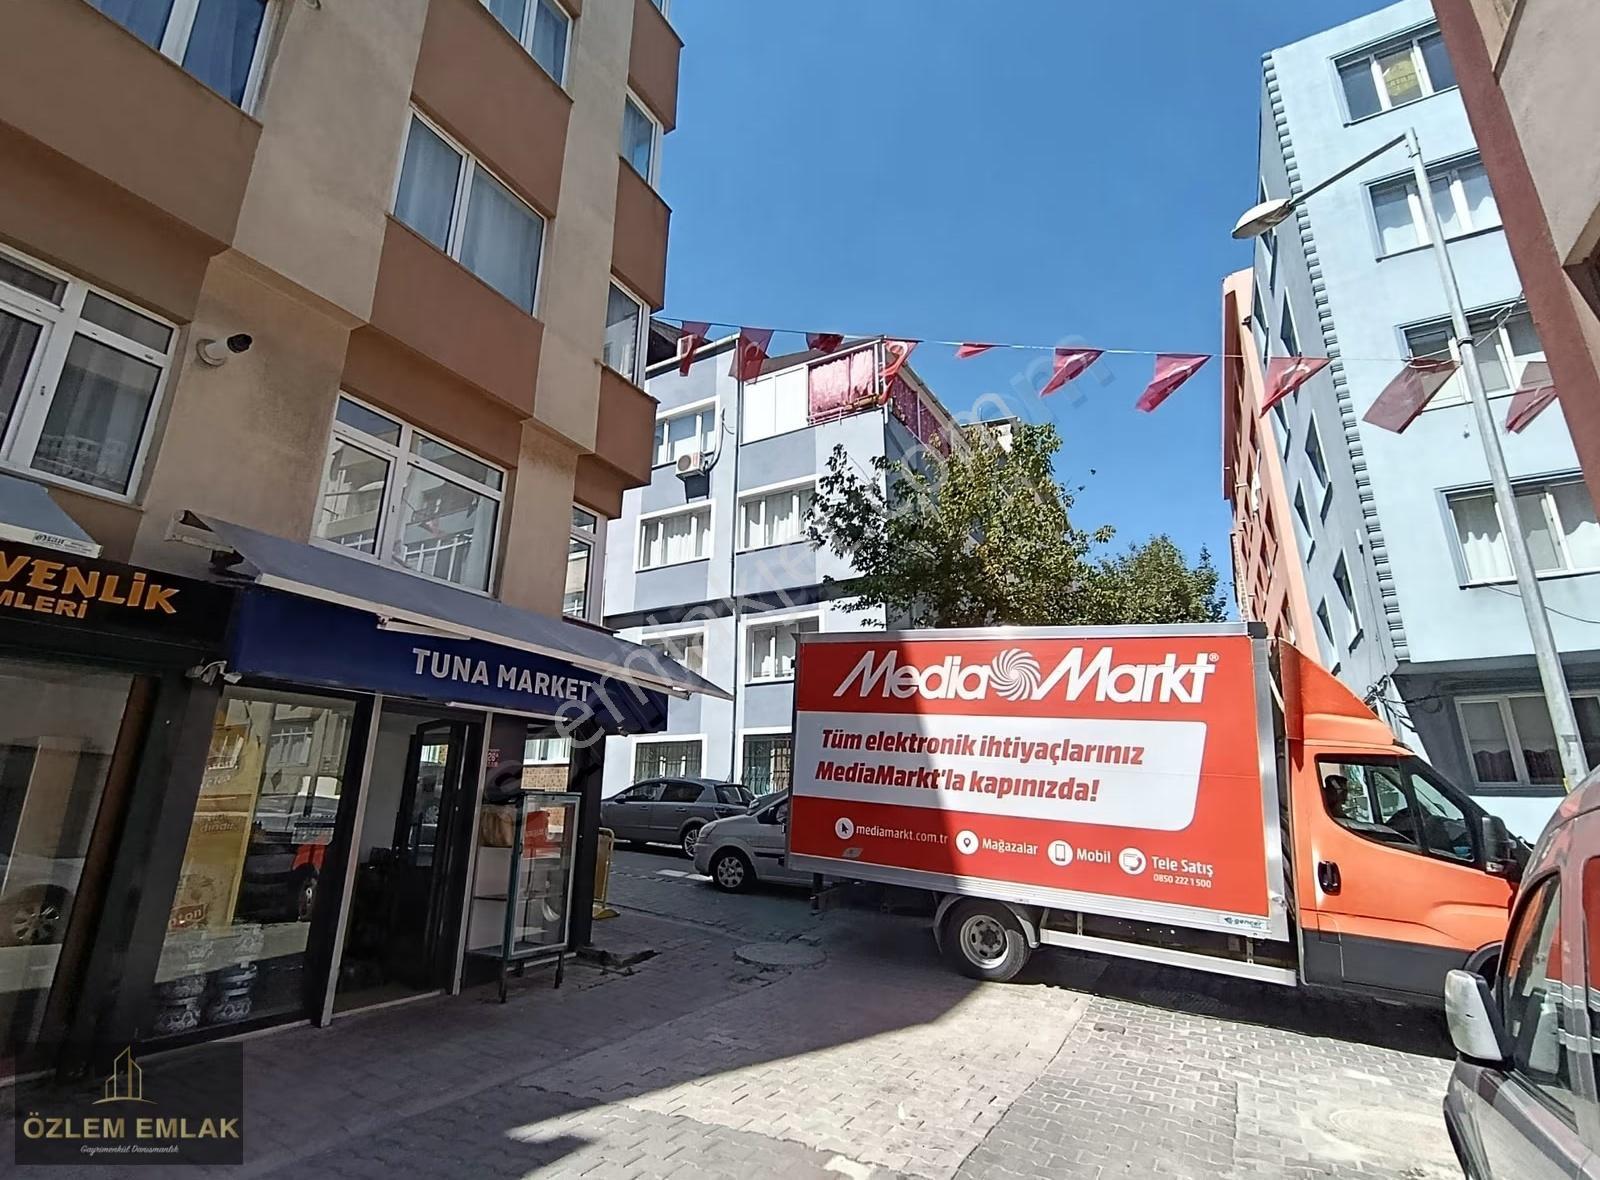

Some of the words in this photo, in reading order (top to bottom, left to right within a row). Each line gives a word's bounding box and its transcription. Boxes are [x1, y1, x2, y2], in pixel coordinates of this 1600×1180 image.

[413, 648, 489, 686] TUNA
[497, 664, 592, 702] MARKET
[822, 729, 862, 750] Tüm
[865, 731, 977, 756] elektronik
[979, 735, 1145, 766] ihtiyaçlarınız
[815, 761, 966, 791] MediaMarkt'la
[969, 770, 1100, 802] kapınızda!
[856, 824, 948, 844] mediamarkt.com.tr
[982, 838, 1038, 855] Mağazalar
[1076, 848, 1111, 864] Mobil
[1151, 856, 1178, 871] Tele
[1181, 859, 1214, 878] Satış
[1153, 873, 1174, 884] 0850
[1175, 875, 1189, 885] 222
